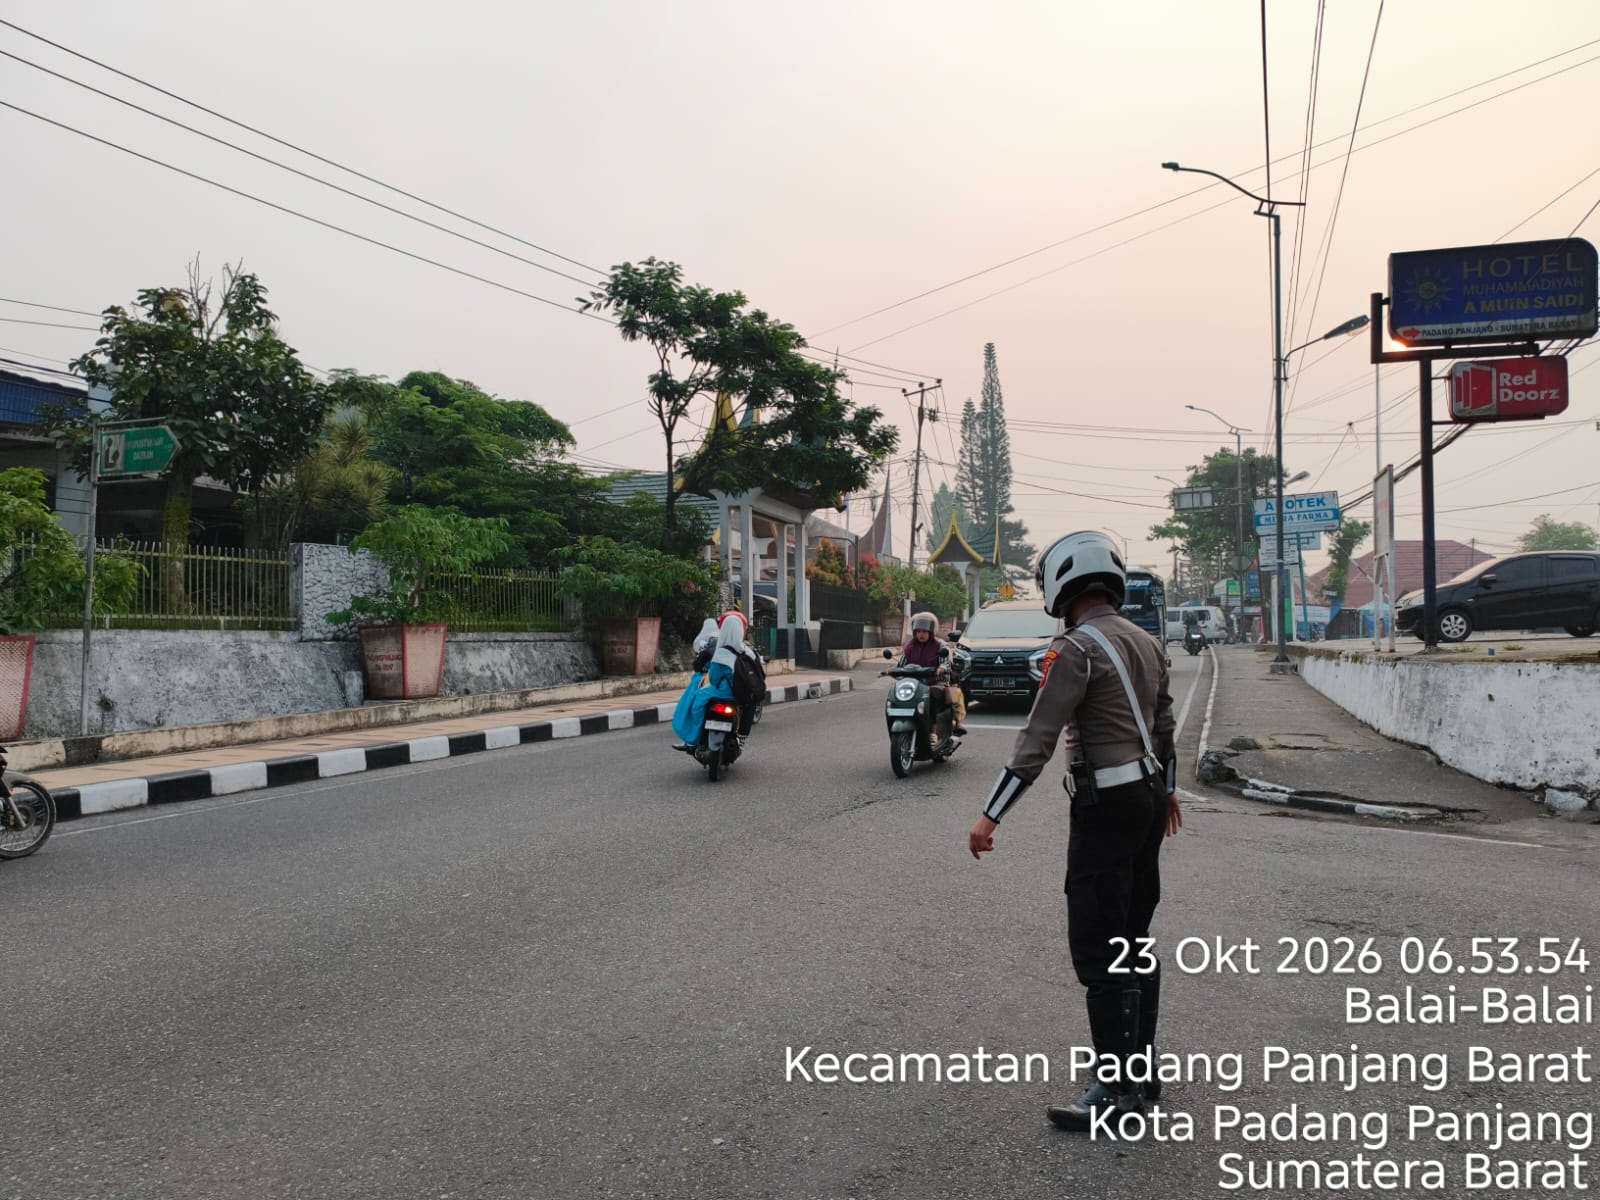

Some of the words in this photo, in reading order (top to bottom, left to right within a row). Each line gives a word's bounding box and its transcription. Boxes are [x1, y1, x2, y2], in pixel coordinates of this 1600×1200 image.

[1463, 252, 1585, 279] HOTEL
[1463, 276, 1585, 297] MUHAMMADIYAH
[1463, 301, 1477, 314] A
[1533, 293, 1585, 309] SAIDI
[1421, 327, 1453, 337] PADANG
[1455, 324, 1493, 335] PANJANG
[1501, 322, 1546, 333] SUMATERA
[1548, 320, 1577, 330] BARAT
[1500, 369, 1537, 386] Red
[1500, 388, 1560, 403] Doorz
[1265, 496, 1326, 512] AOTEK
[1264, 514, 1294, 523] MIRA
[1297, 511, 1329, 521] FARMA
